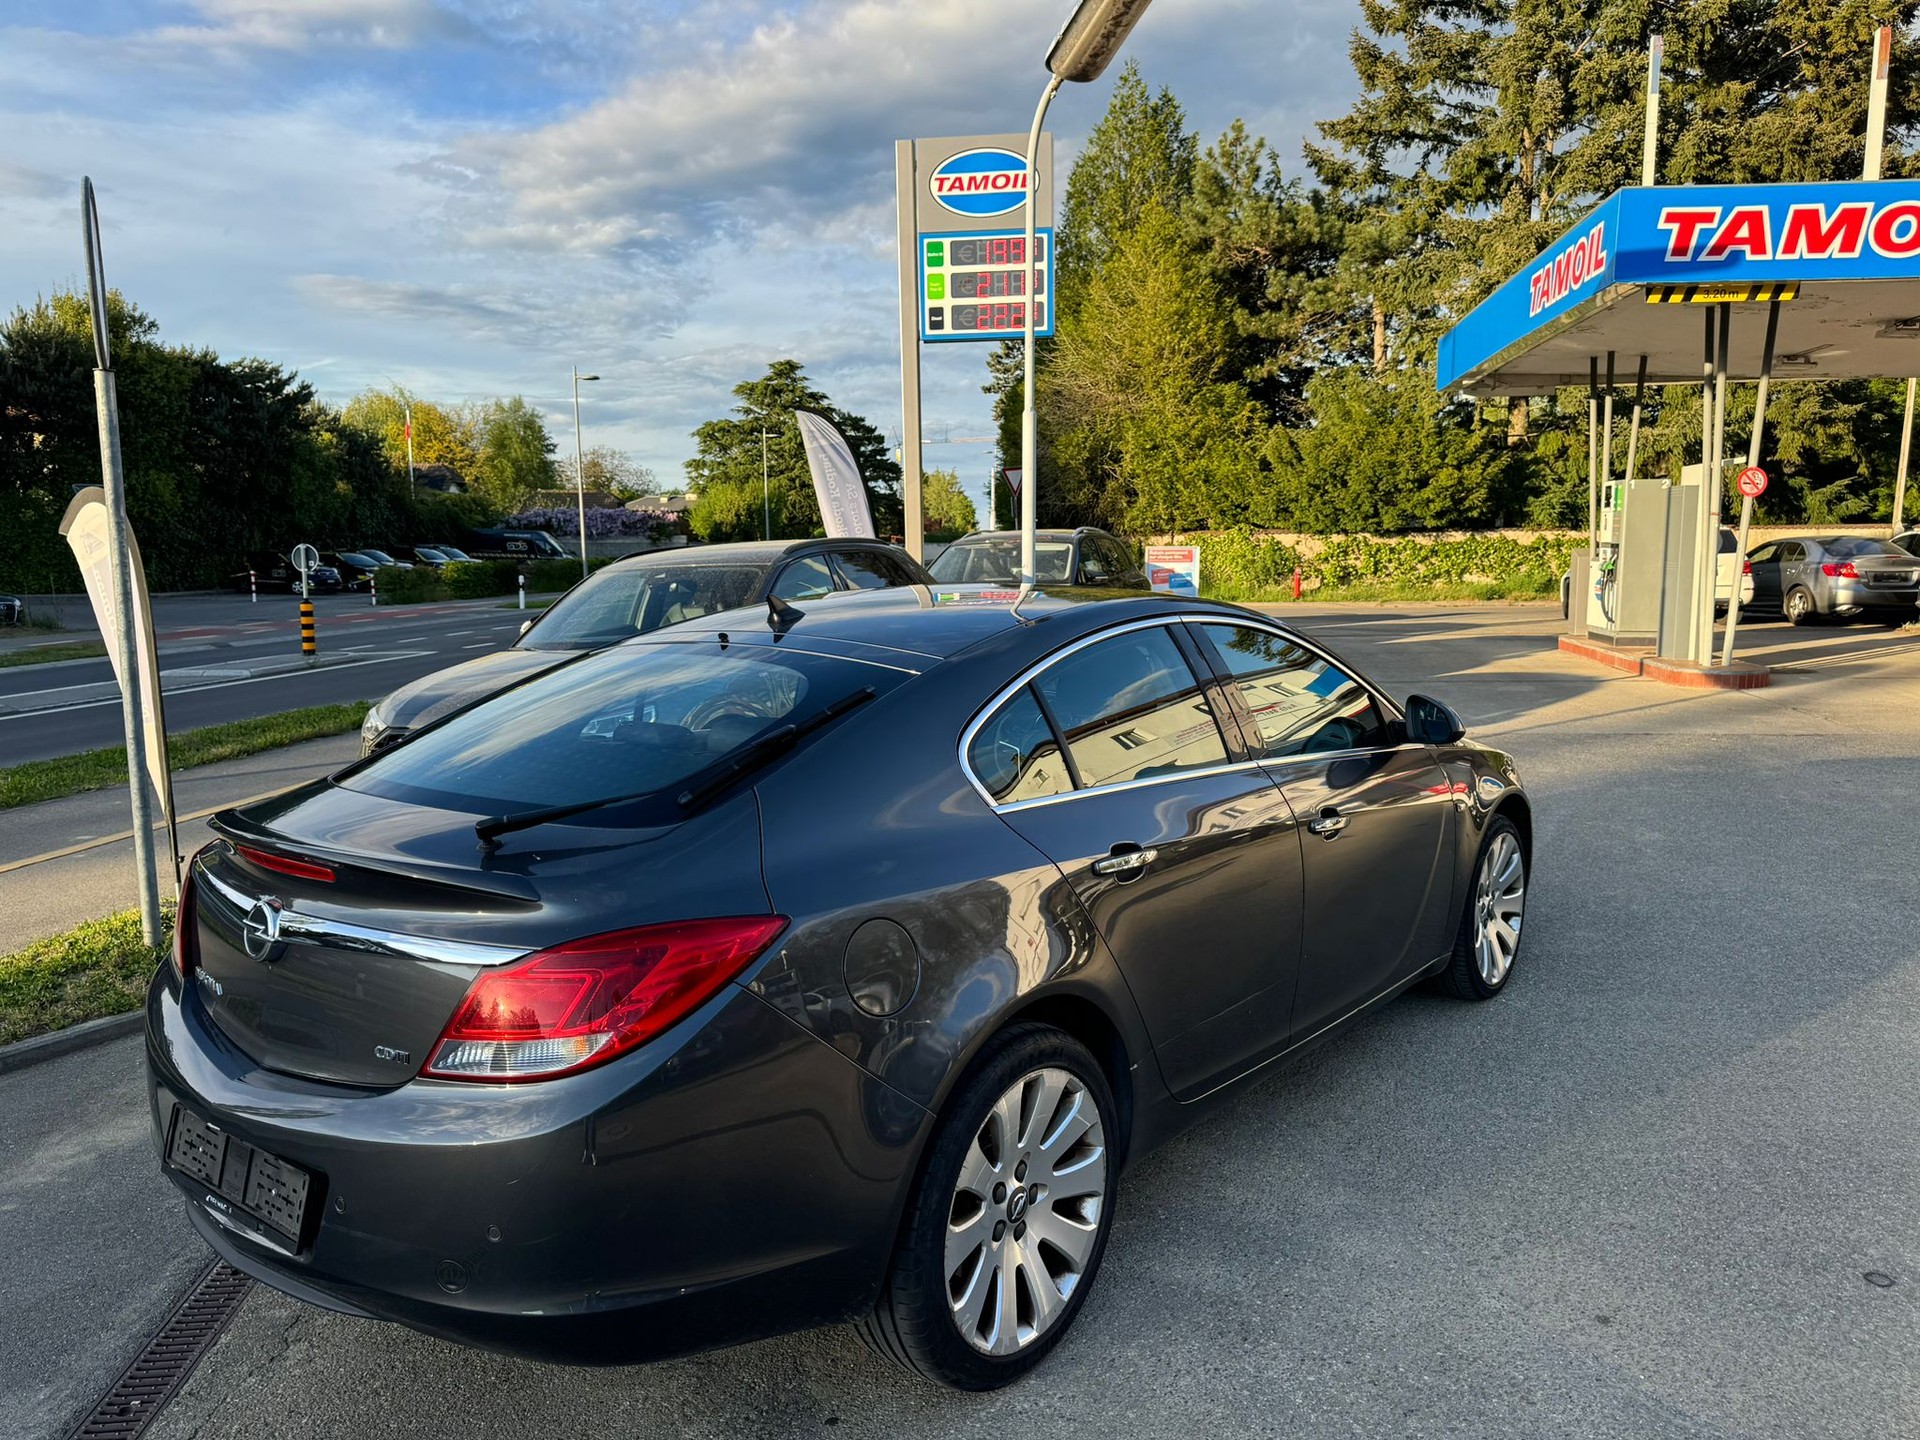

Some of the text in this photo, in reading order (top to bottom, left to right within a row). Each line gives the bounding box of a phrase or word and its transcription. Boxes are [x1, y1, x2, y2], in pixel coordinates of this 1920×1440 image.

[1529, 221, 1607, 318] TAMOIL
[1703, 289, 1726, 299] 3.20
[1661, 480, 1671, 489] 2
